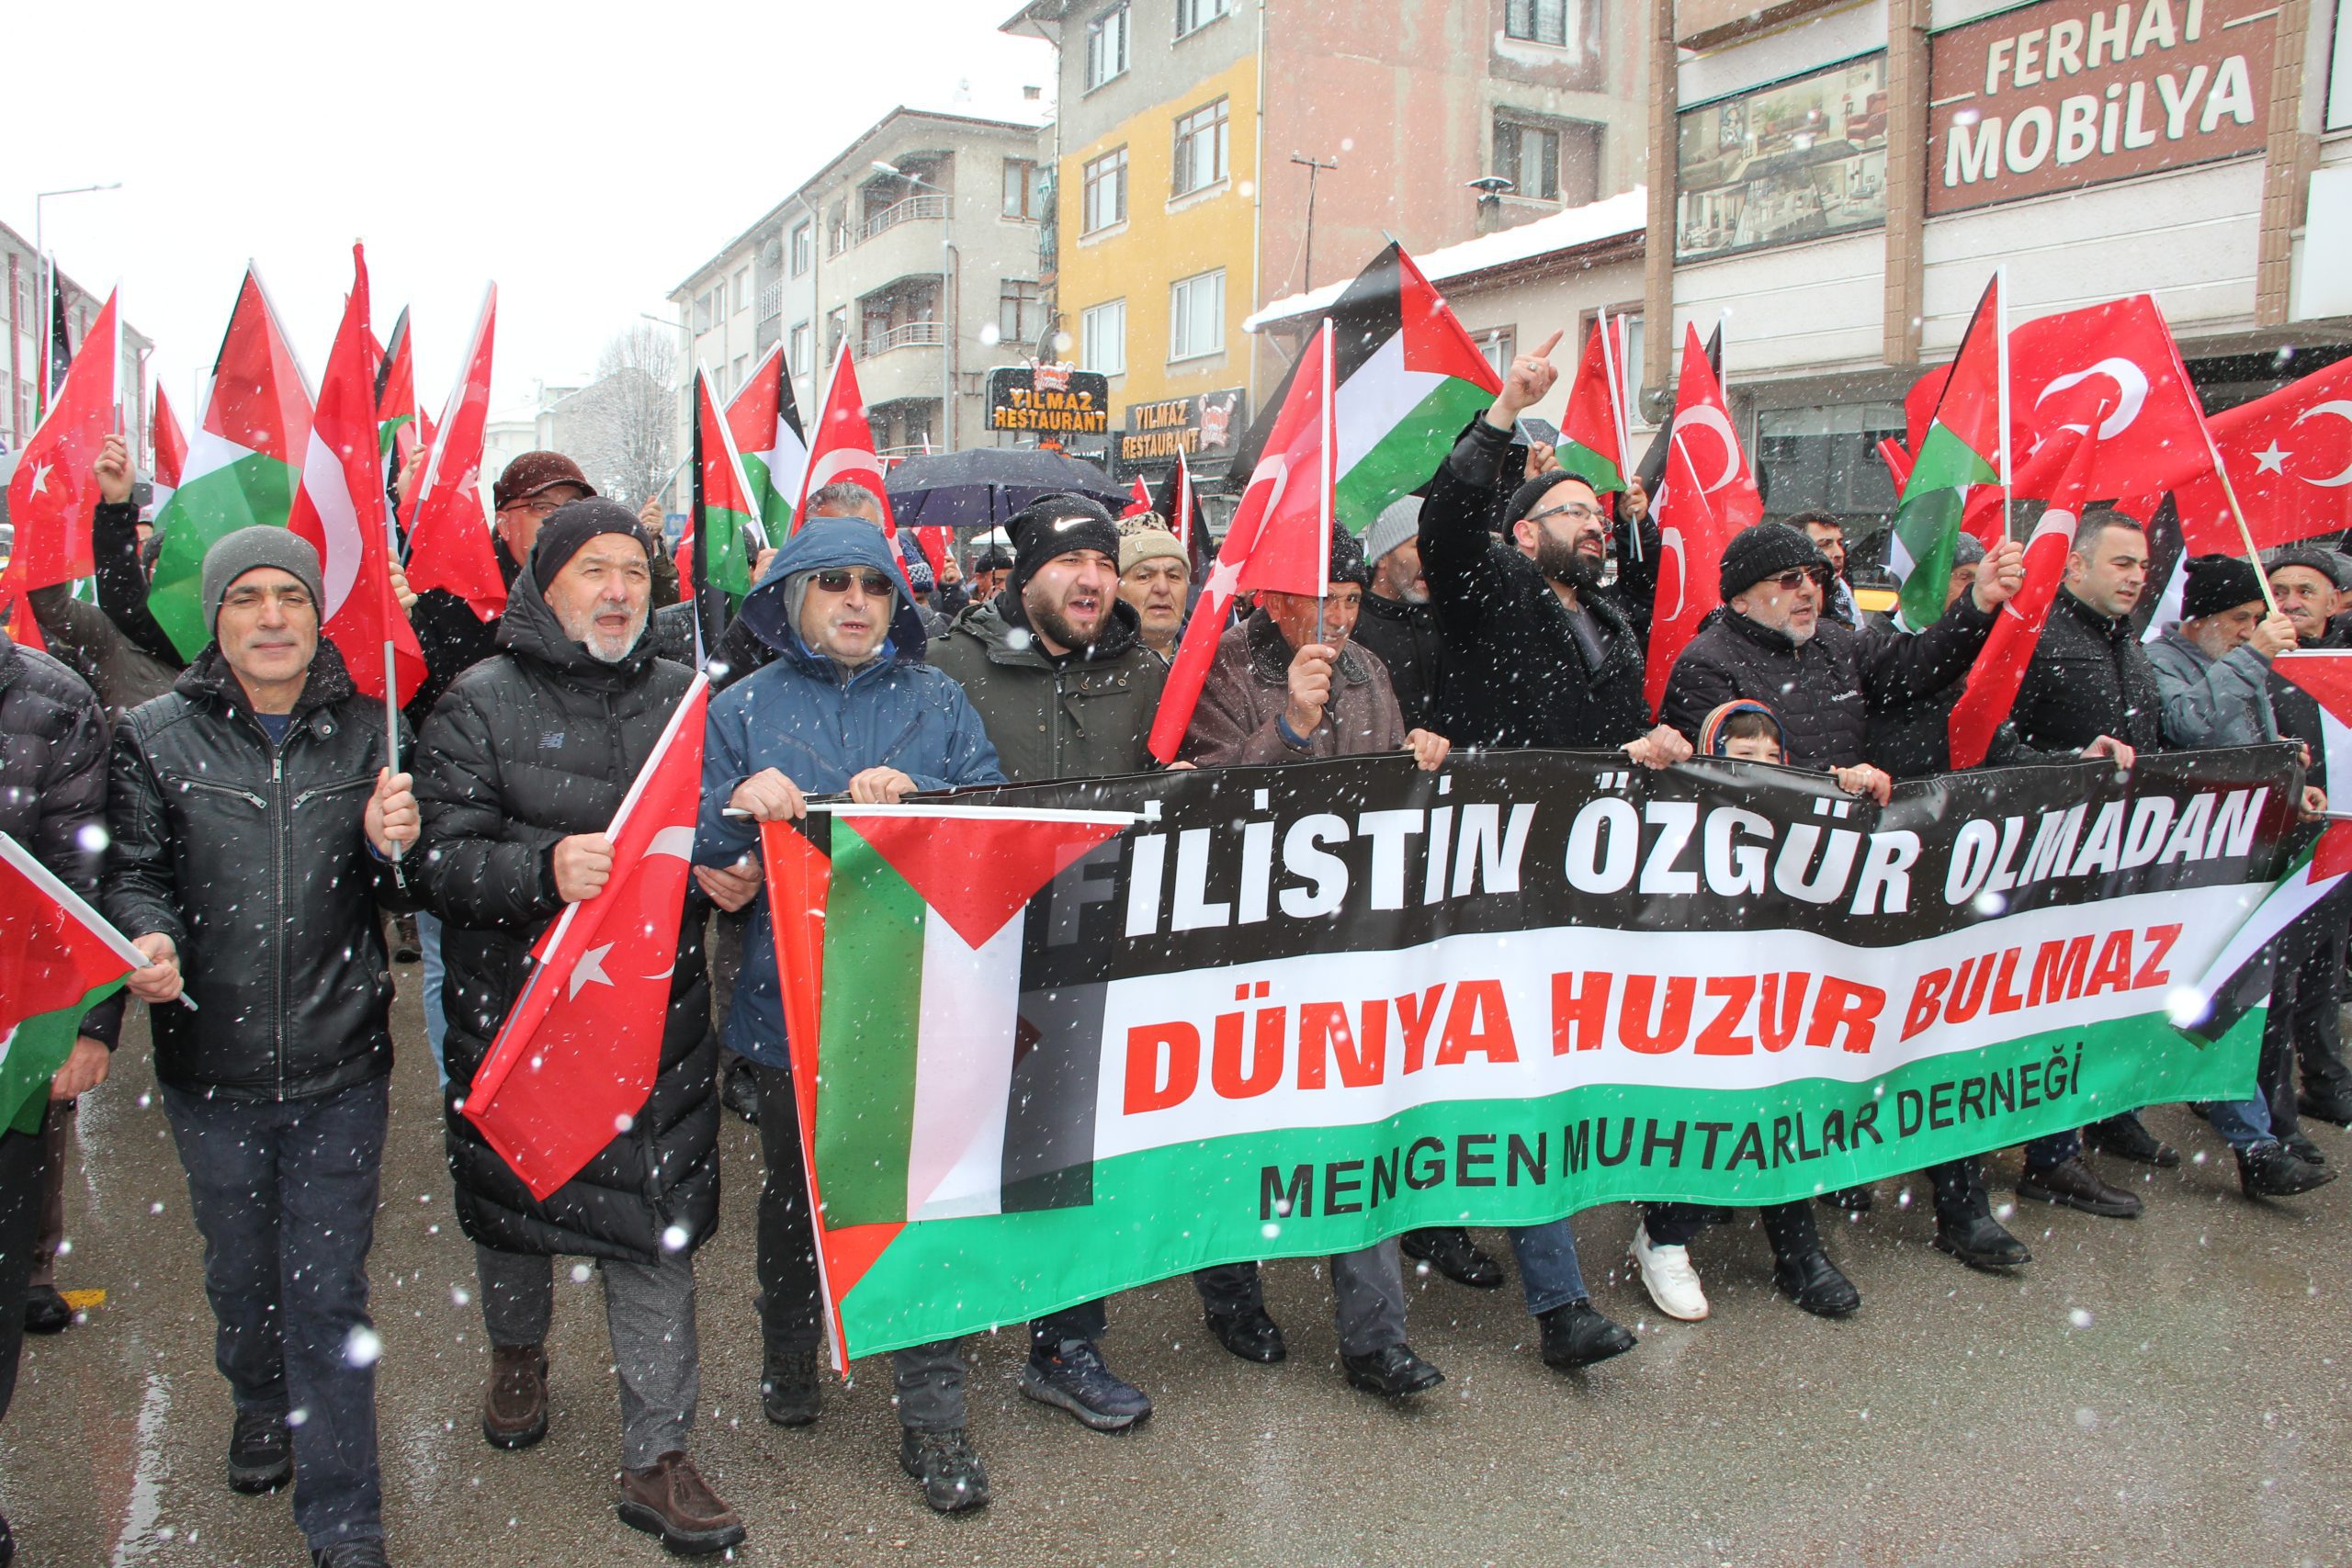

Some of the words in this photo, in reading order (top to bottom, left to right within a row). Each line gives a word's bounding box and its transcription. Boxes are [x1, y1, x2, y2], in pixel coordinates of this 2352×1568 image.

[1010, 389, 1092, 412] YILMAZ
[1136, 400, 1189, 430] YILMAZ
[995, 407, 1106, 432] RESTAURANT
[1123, 428, 1199, 459] RESTAURANT
[1046, 775, 1538, 948] FİLİSTİN
[1565, 772, 1920, 915] ÖZGÜR
[1945, 787, 2269, 906] OLMADAN
[1123, 979, 1520, 1116] DÜNYA
[1551, 971, 1886, 1056] HUZUR
[1900, 923, 2183, 1042] BULMAZ
[1260, 1132, 1547, 1221] MENGEN
[1563, 1100, 1883, 1178] MUHTARLAR
[1897, 1041, 2084, 1138] DERNEĞİ
